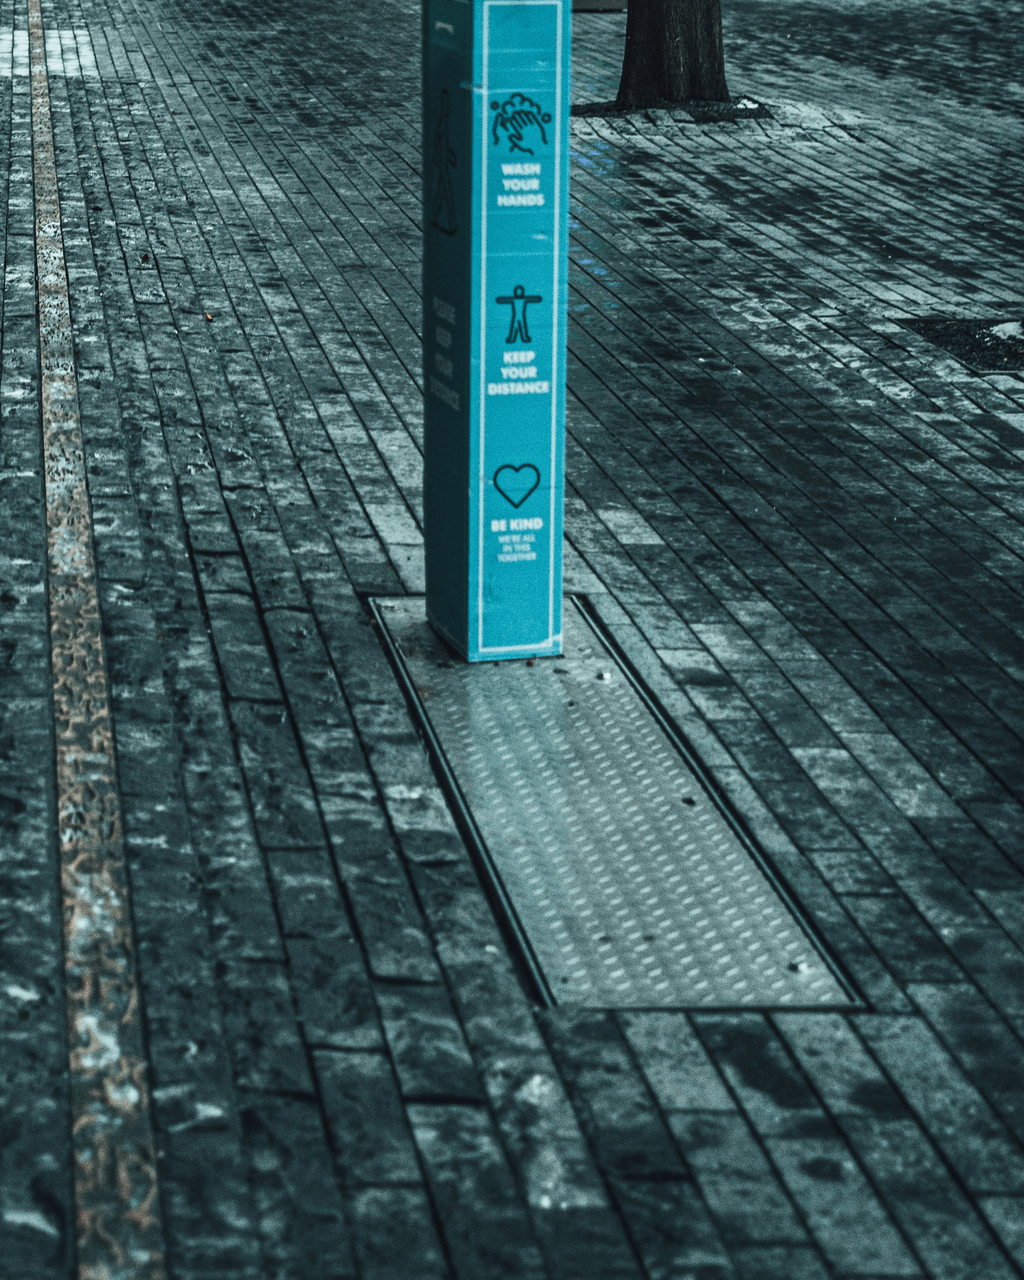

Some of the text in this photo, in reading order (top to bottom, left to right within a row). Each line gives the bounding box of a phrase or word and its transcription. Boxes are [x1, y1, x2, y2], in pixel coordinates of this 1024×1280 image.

[501, 163, 542, 176] WASH
[502, 178, 541, 191] YOUR
[496, 193, 545, 207] HANDS
[503, 351, 535, 364] KEEP
[500, 366, 538, 379] YOUR
[488, 381, 550, 395] DISTANCE
[491, 517, 543, 532] BE KIND
